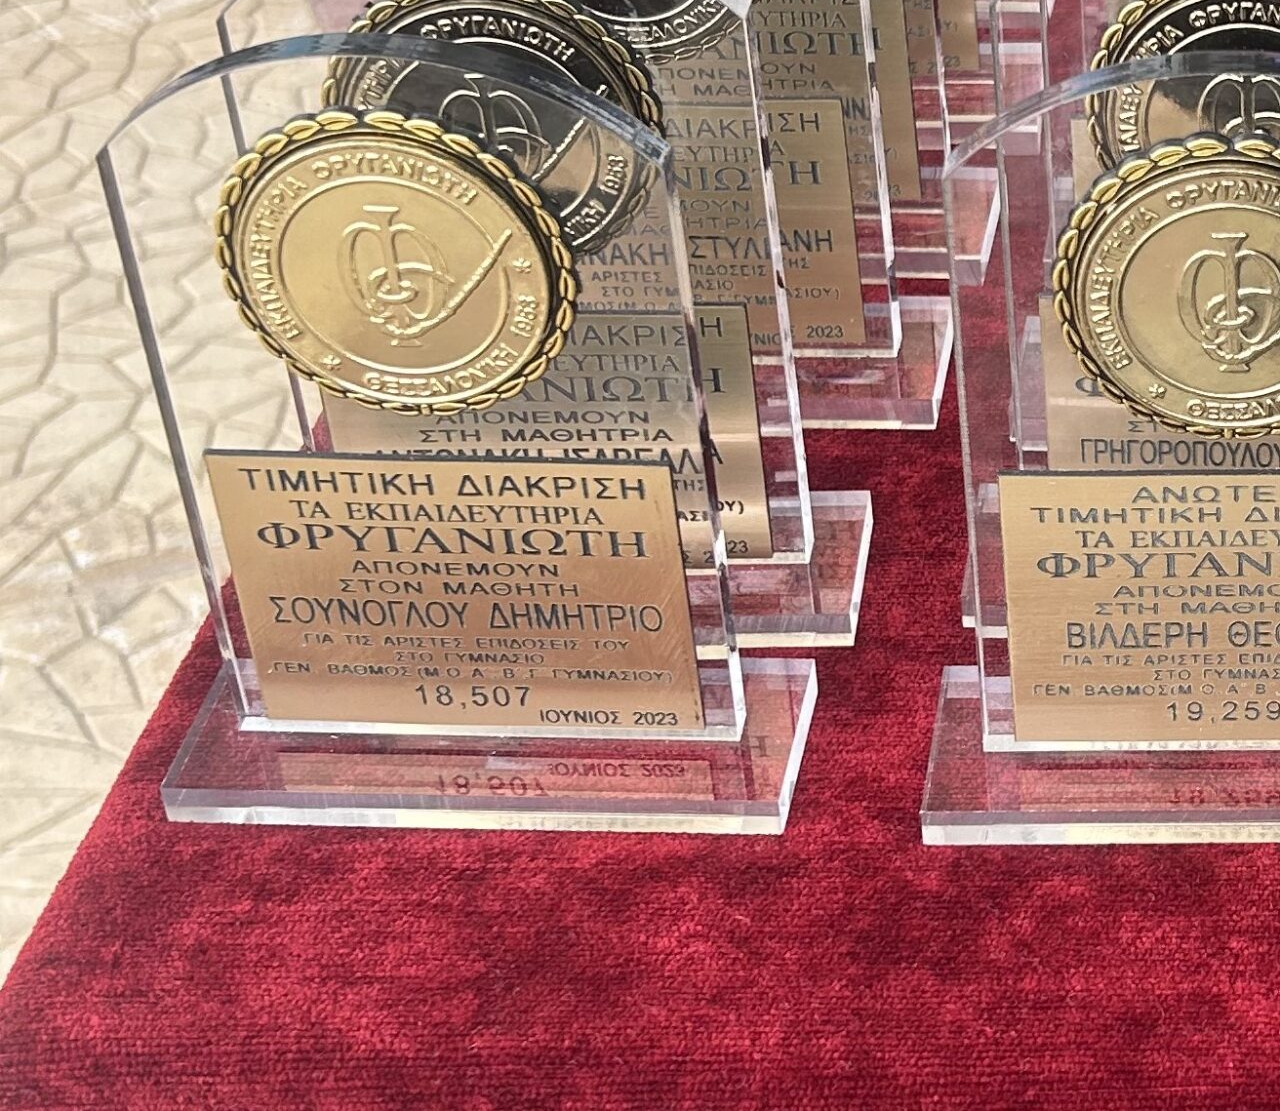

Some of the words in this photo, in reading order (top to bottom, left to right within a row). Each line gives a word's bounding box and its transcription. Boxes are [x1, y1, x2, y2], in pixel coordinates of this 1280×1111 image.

[688, 264, 766, 277] ΠΙΔΟΣΕΙΣ
[806, 325, 843, 339] 2023
[419, 429, 482, 443] ΣΤΗ
[501, 428, 674, 443] ΜΑΘΗΤΡΙΑ
[238, 468, 436, 497] ΤΙΜΗΤΙΚΗ
[457, 474, 646, 501] ΔΙΑΚΡΙΣΗ
[289, 500, 330, 520] ΤΑ
[346, 501, 605, 526] ΕΚΠΑΙΔΕΥΤΗΡΙΑ
[1030, 506, 1222, 523] ΤΙΜΗΤΙΚΗ
[257, 521, 650, 558] ΦΡΥΓΑΝΙΩΤΗ
[1075, 530, 1114, 548] ΤΑ
[352, 559, 560, 578] ΑΠΟΝΕΜΟΥΝ
[339, 578, 427, 595] ΣΤΟΝ
[442, 581, 579, 598] ΜΑΘΗΤΗ
[269, 596, 470, 629] ΣΟΥΝΟΓΛΟΥ
[489, 602, 664, 632] ΔΗΜΗΤΡΙΟ
[1095, 601, 1159, 615] ΣΤΗ
[303, 633, 334, 646] ΓΙΑ
[345, 634, 372, 647] ΤΙΣ
[383, 635, 464, 649] ΑΡΙΣΤΕΣ
[475, 637, 580, 650] ΕΠΙΔΟΣΕΙΣ
[592, 638, 630, 651] ΤΟΥ
[1066, 621, 1208, 650] ΒΙΛΔΕΡΗ
[394, 650, 433, 664] ΣΤΟ
[444, 651, 545, 666] ΓΥΜΝΑΣΙΟ
[1062, 654, 1093, 666] ΓΙΑ
[1104, 654, 1133, 666] ΤΙΣ
[1143, 653, 1227, 666] ΑΡΙΣΤΕΣ
[1153, 668, 1191, 681] ΣΤΟ
[414, 685, 532, 709] 18,507
[539, 709, 622, 725] ΙΟΥΝΙΟΣ
[631, 710, 678, 726] 2023
